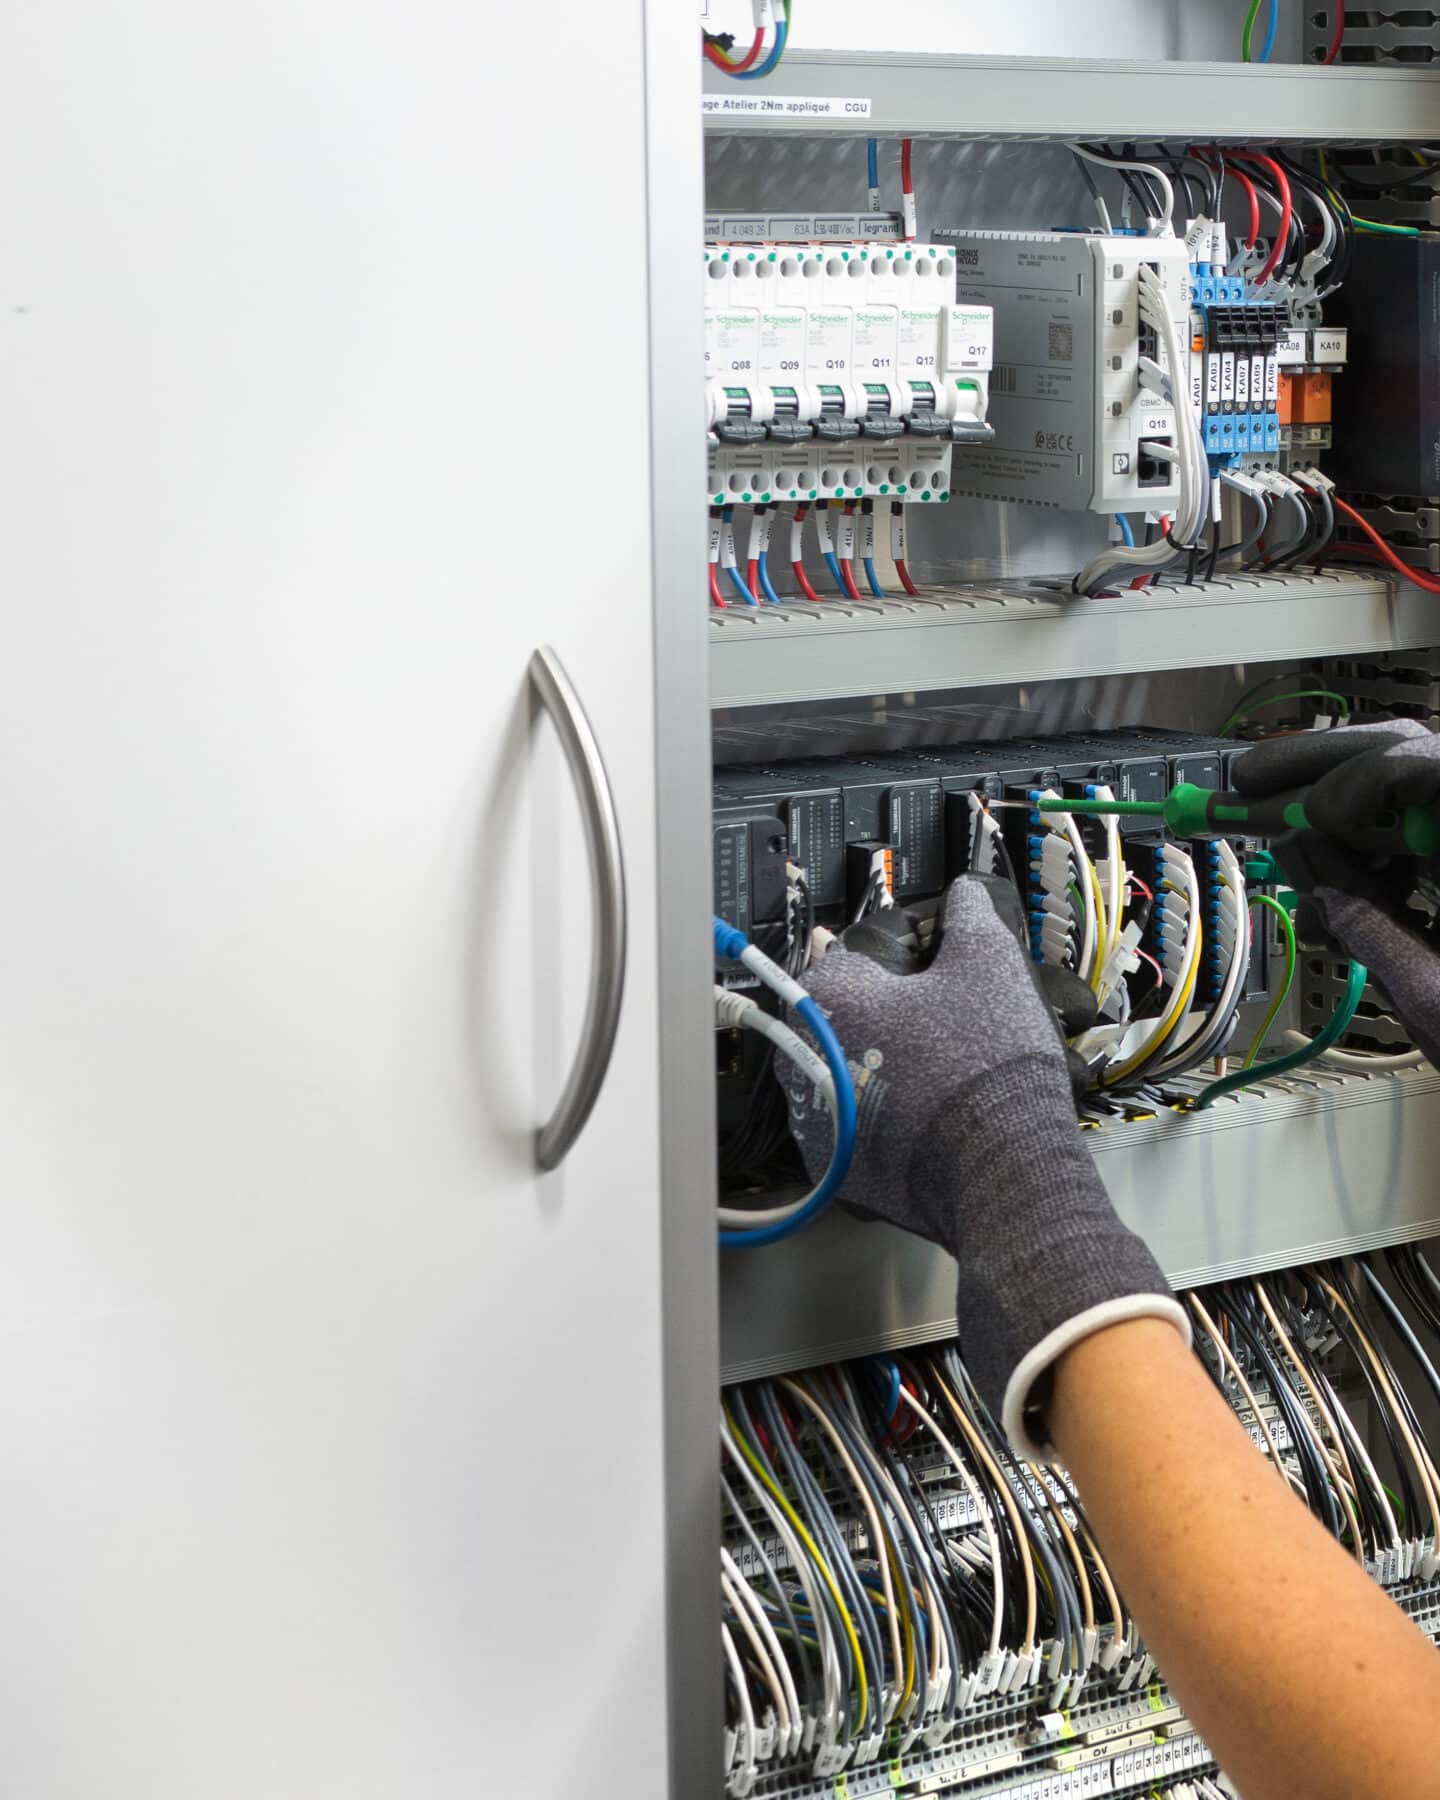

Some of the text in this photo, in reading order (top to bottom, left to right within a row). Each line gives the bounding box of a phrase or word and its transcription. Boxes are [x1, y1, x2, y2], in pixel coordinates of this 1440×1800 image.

[723, 99, 757, 110] Atelier
[761, 100, 783, 110] 2Nm
[786, 102, 830, 113] appliqué
[845, 103, 867, 112] CGU
[864, 224, 899, 235] legrand
[952, 311, 991, 325] Schneider
[968, 346, 986, 355] Q17
[1320, 342, 1340, 350] KA10
[826, 360, 845, 369] Q10
[872, 358, 890, 368] Q11
[915, 356, 934, 365] Q12
[731, 361, 751, 370] Q08
[780, 361, 799, 370] Q09
[1149, 420, 1166, 429] Q18
[1044, 1788, 1049, 1797] 44
[1054, 1784, 1060, 1794] 45
[1073, 1779, 1079, 1788] 47
[1083, 1775, 1089, 1785] 48
[1135, 1761, 1142, 1770] 53
[1146, 1758, 1152, 1767] 54
[1155, 1755, 1162, 1764] 55
[1165, 1752, 1171, 1761] 56
[1175, 1749, 1181, 1758] 57
[1184, 1746, 1190, 1756] 58
